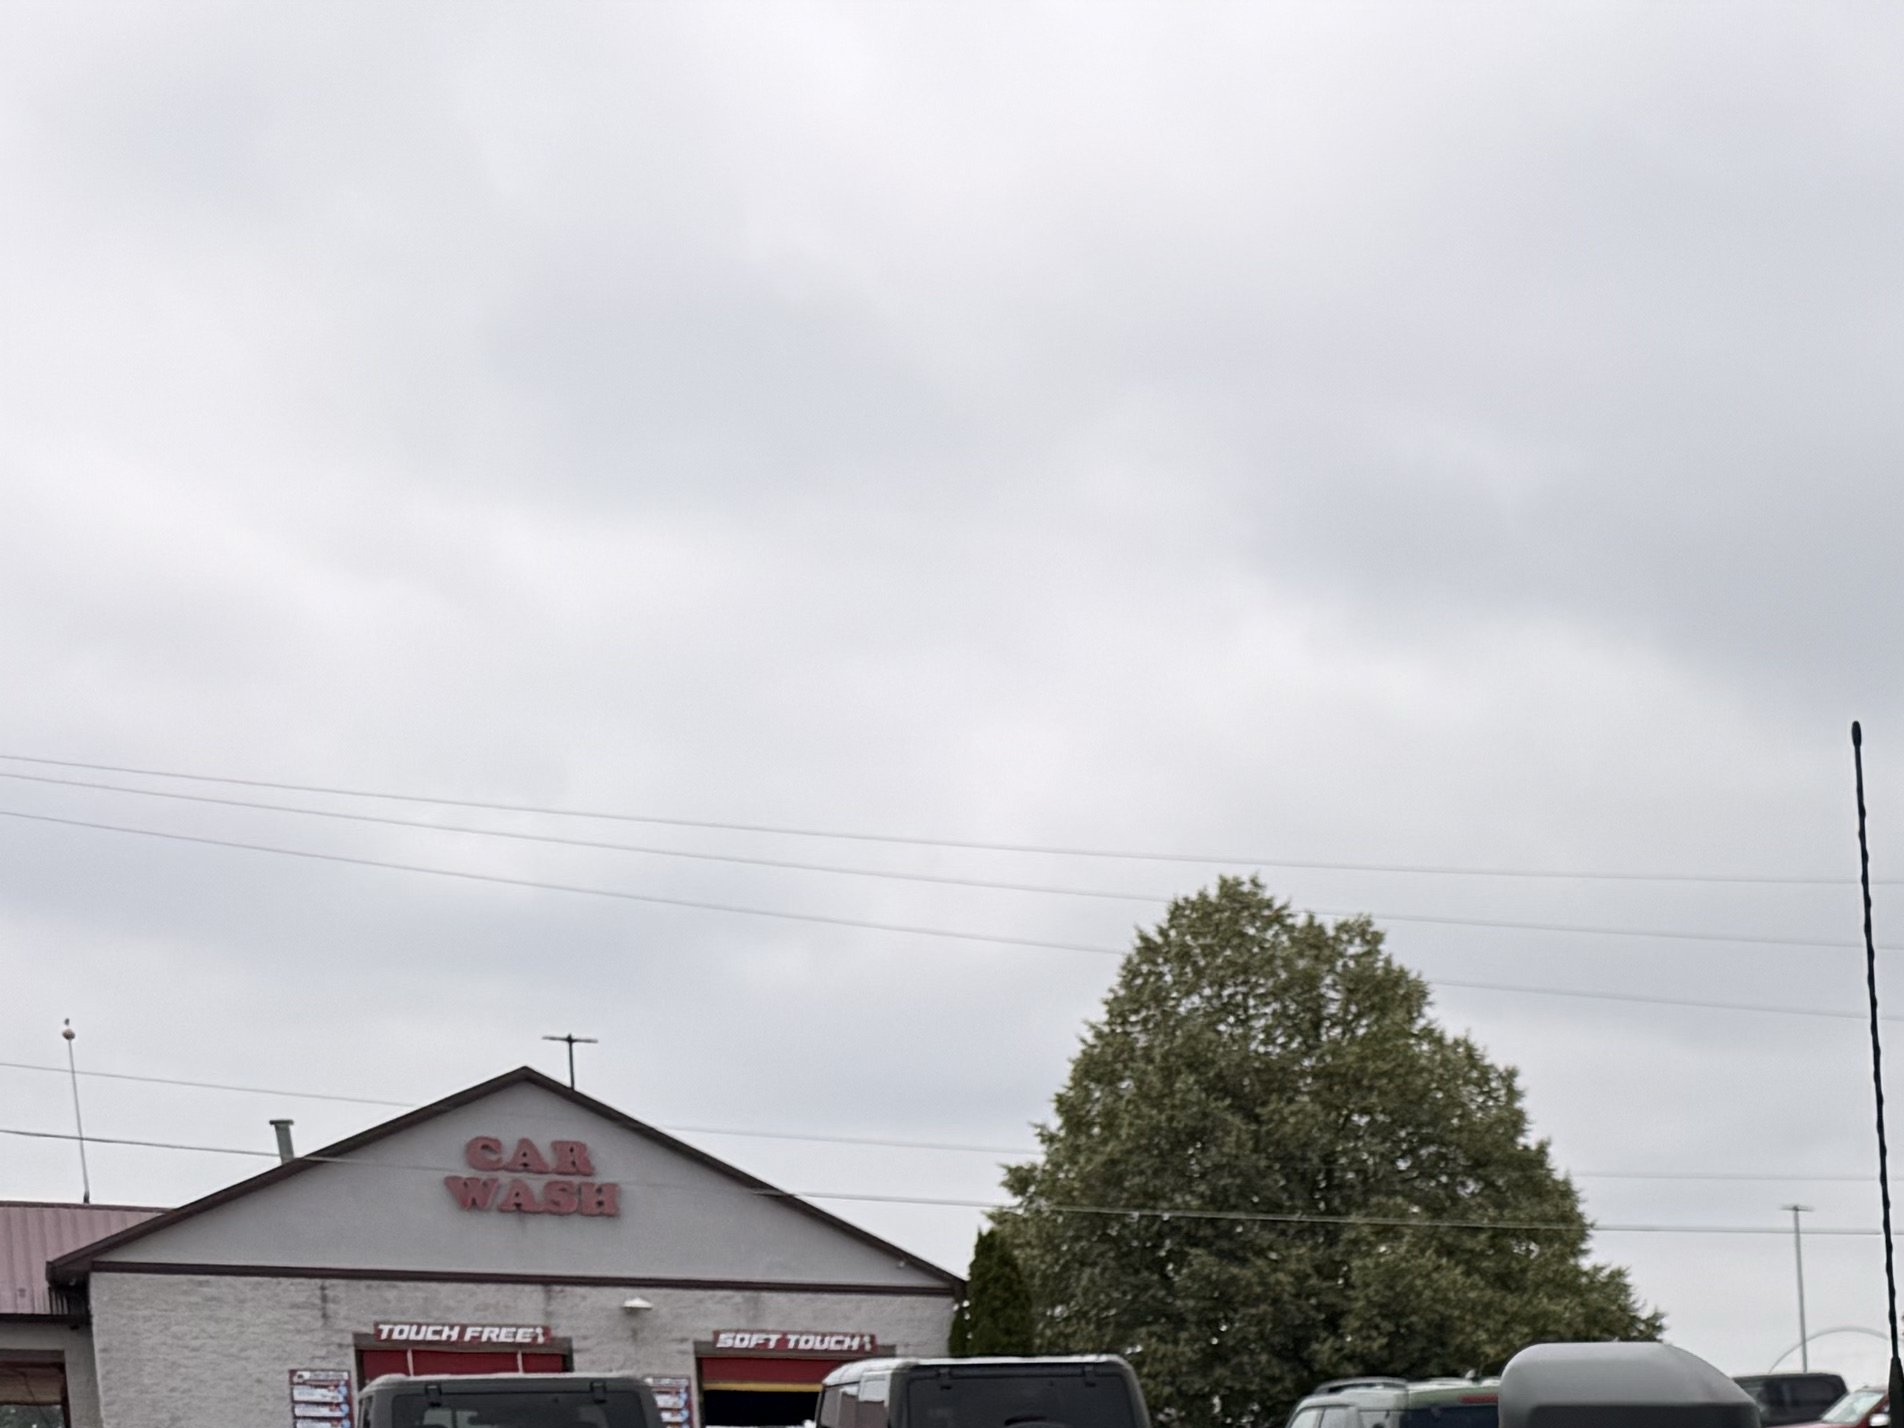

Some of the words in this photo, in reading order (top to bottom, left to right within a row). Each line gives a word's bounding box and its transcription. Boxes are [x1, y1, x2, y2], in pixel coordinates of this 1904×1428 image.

[465, 1135, 596, 1177] CAR
[443, 1174, 621, 1217] WASH
[378, 1323, 461, 1342] TOUCH
[463, 1325, 537, 1344] FREE
[716, 1332, 783, 1349] SOFT
[785, 1333, 861, 1352] TOUCH
